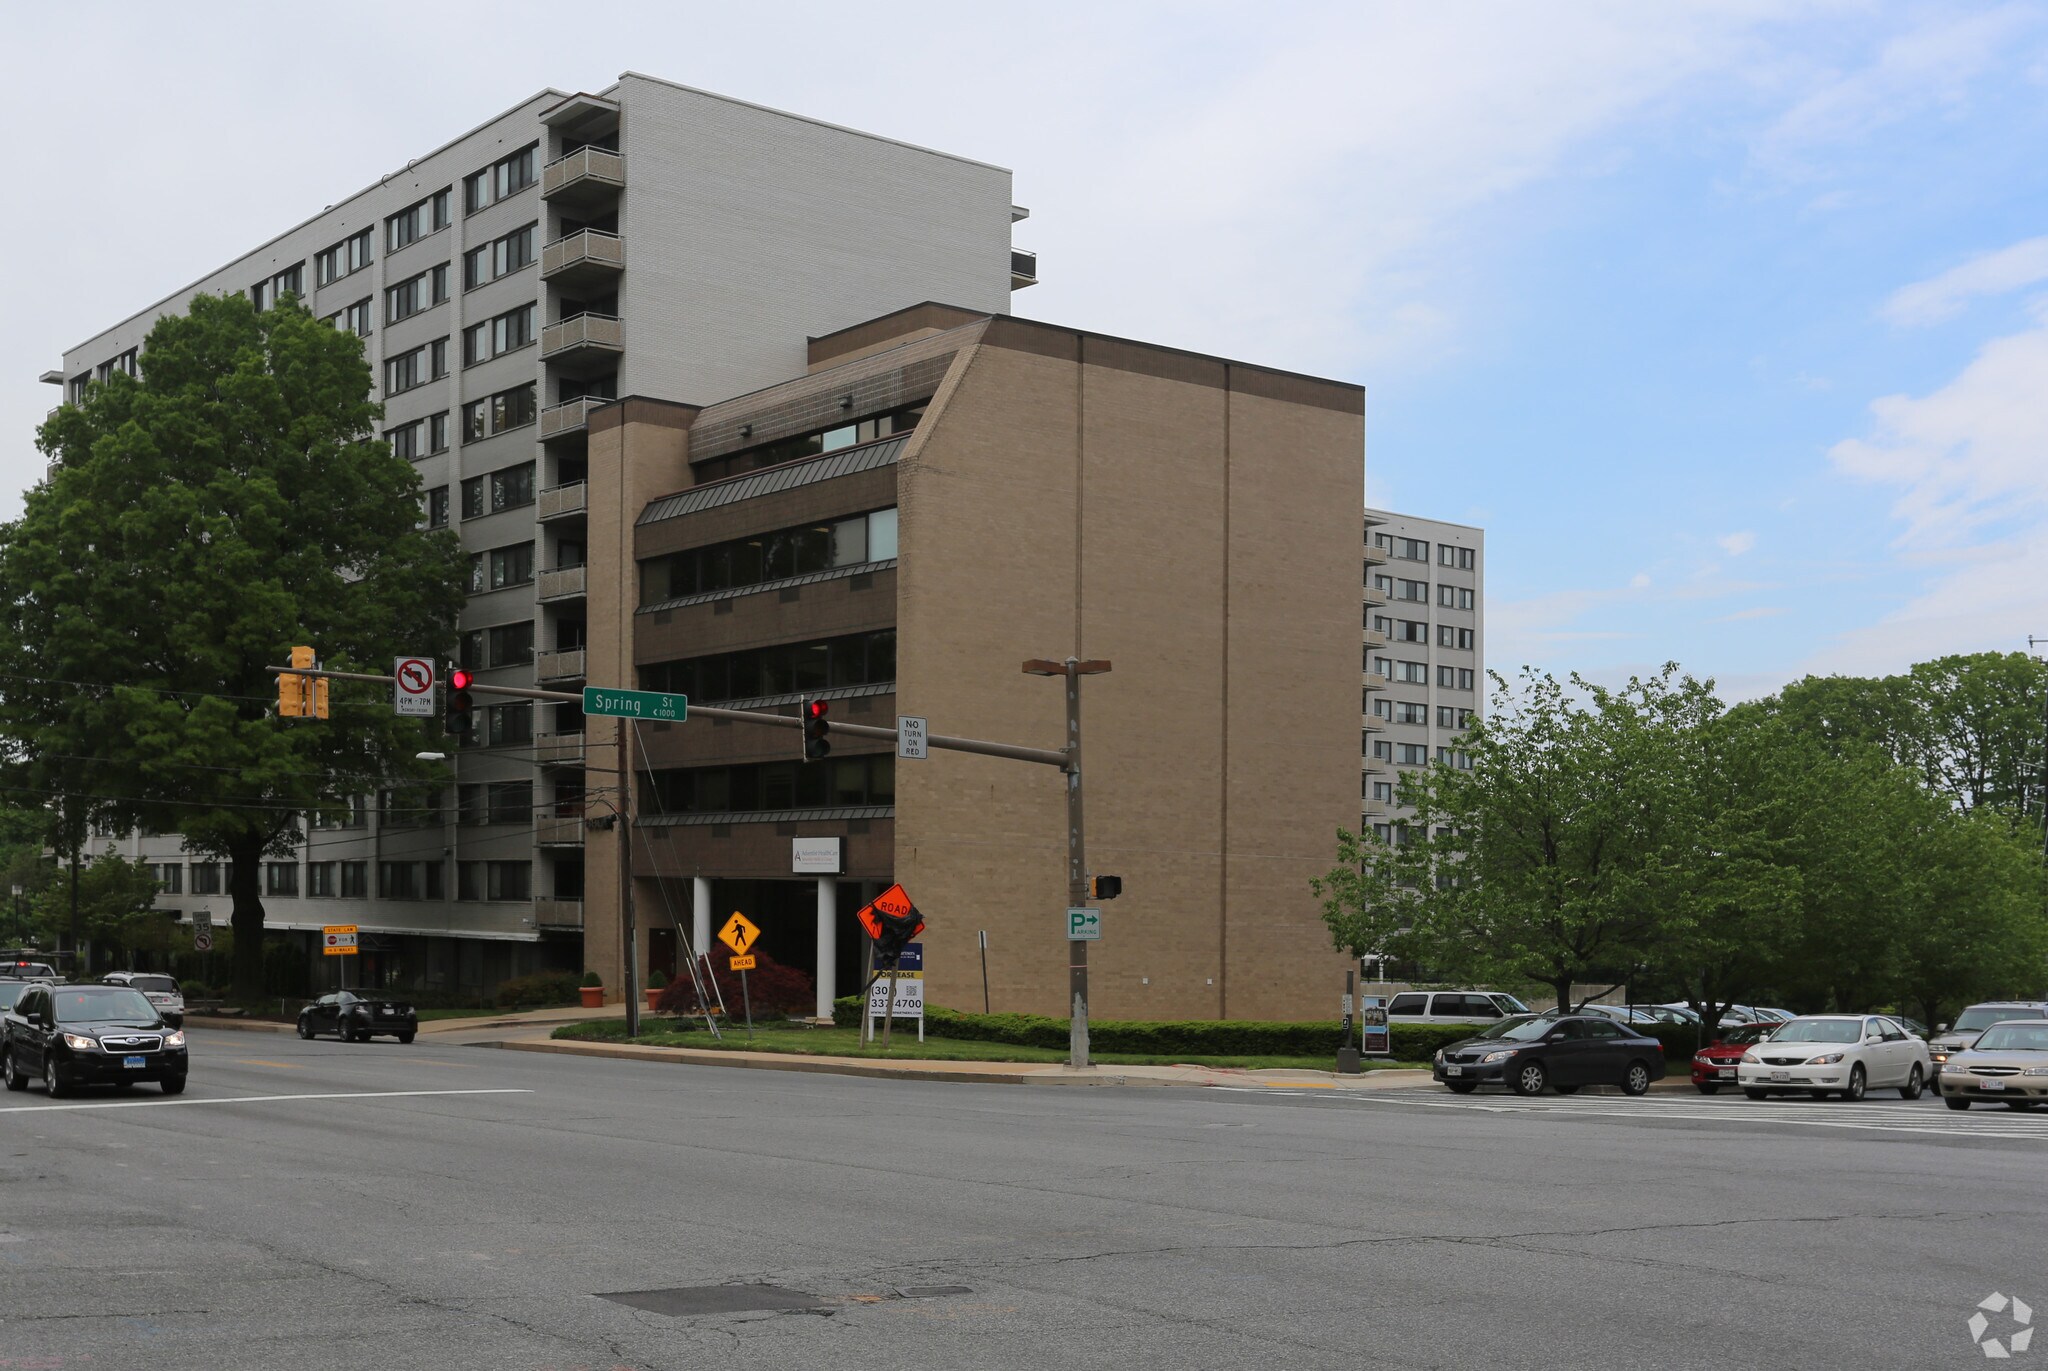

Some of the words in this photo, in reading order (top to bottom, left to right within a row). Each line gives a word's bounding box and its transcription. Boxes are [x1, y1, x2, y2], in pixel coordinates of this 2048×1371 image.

[400, 697, 413, 705] 4PM
[419, 697, 431, 706] 7PM
[595, 694, 640, 716] Spring
[662, 696, 673, 708] St
[659, 709, 676, 717] 1000
[905, 720, 919, 729] NO
[904, 729, 922, 738] TURN
[908, 739, 918, 747] ON
[905, 747, 920, 756] RED
[880, 901, 909, 916] ROAD
[195, 922, 210, 932] 35
[733, 958, 753, 967] AHEAD
[871, 985, 897, 998] (30)
[871, 998, 922, 1009] 3374700
